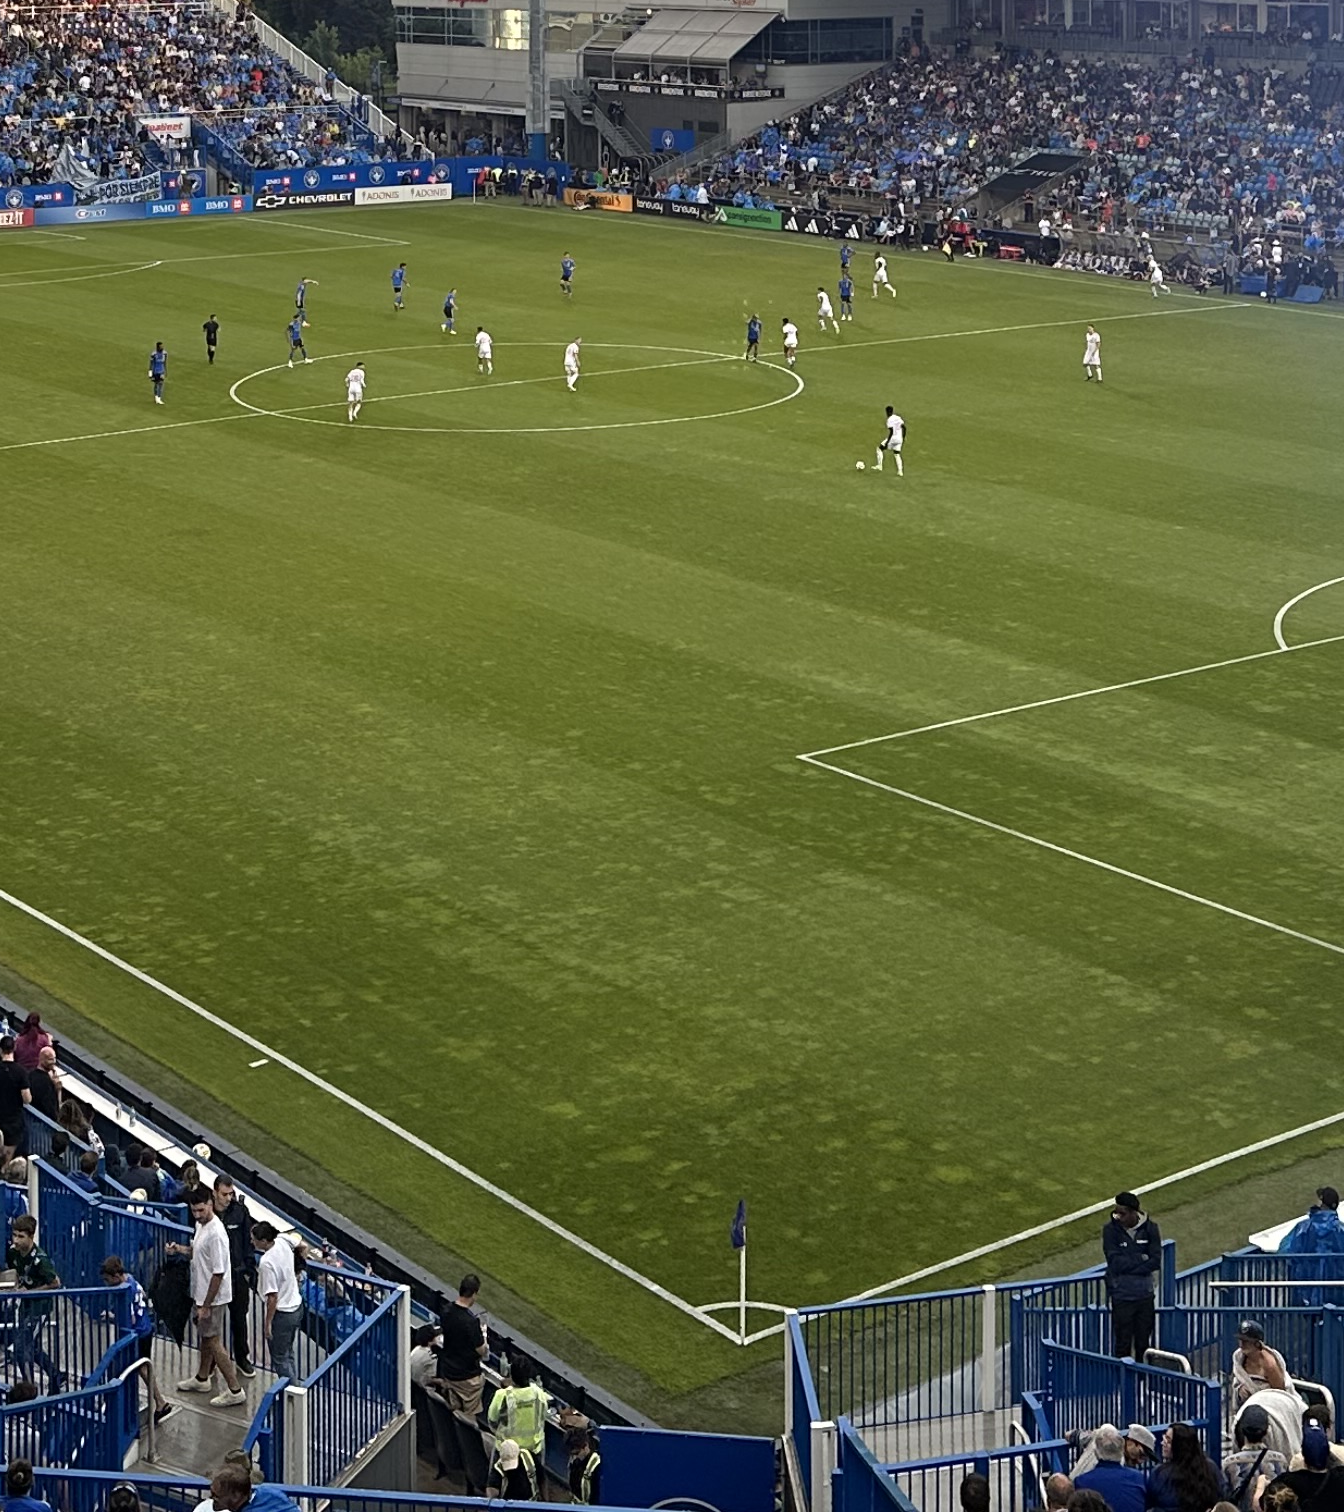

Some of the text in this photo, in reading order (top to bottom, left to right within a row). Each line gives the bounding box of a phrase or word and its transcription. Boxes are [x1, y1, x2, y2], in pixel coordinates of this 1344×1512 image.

[146, 123, 183, 132] ualinet
[1030, 170, 1057, 178] TELU
[366, 190, 400, 200] ADONIS
[415, 187, 448, 198] ADONIS
[289, 192, 353, 205] CHEVROLET
[152, 204, 176, 214] BMO
[206, 200, 229, 210] BMO
